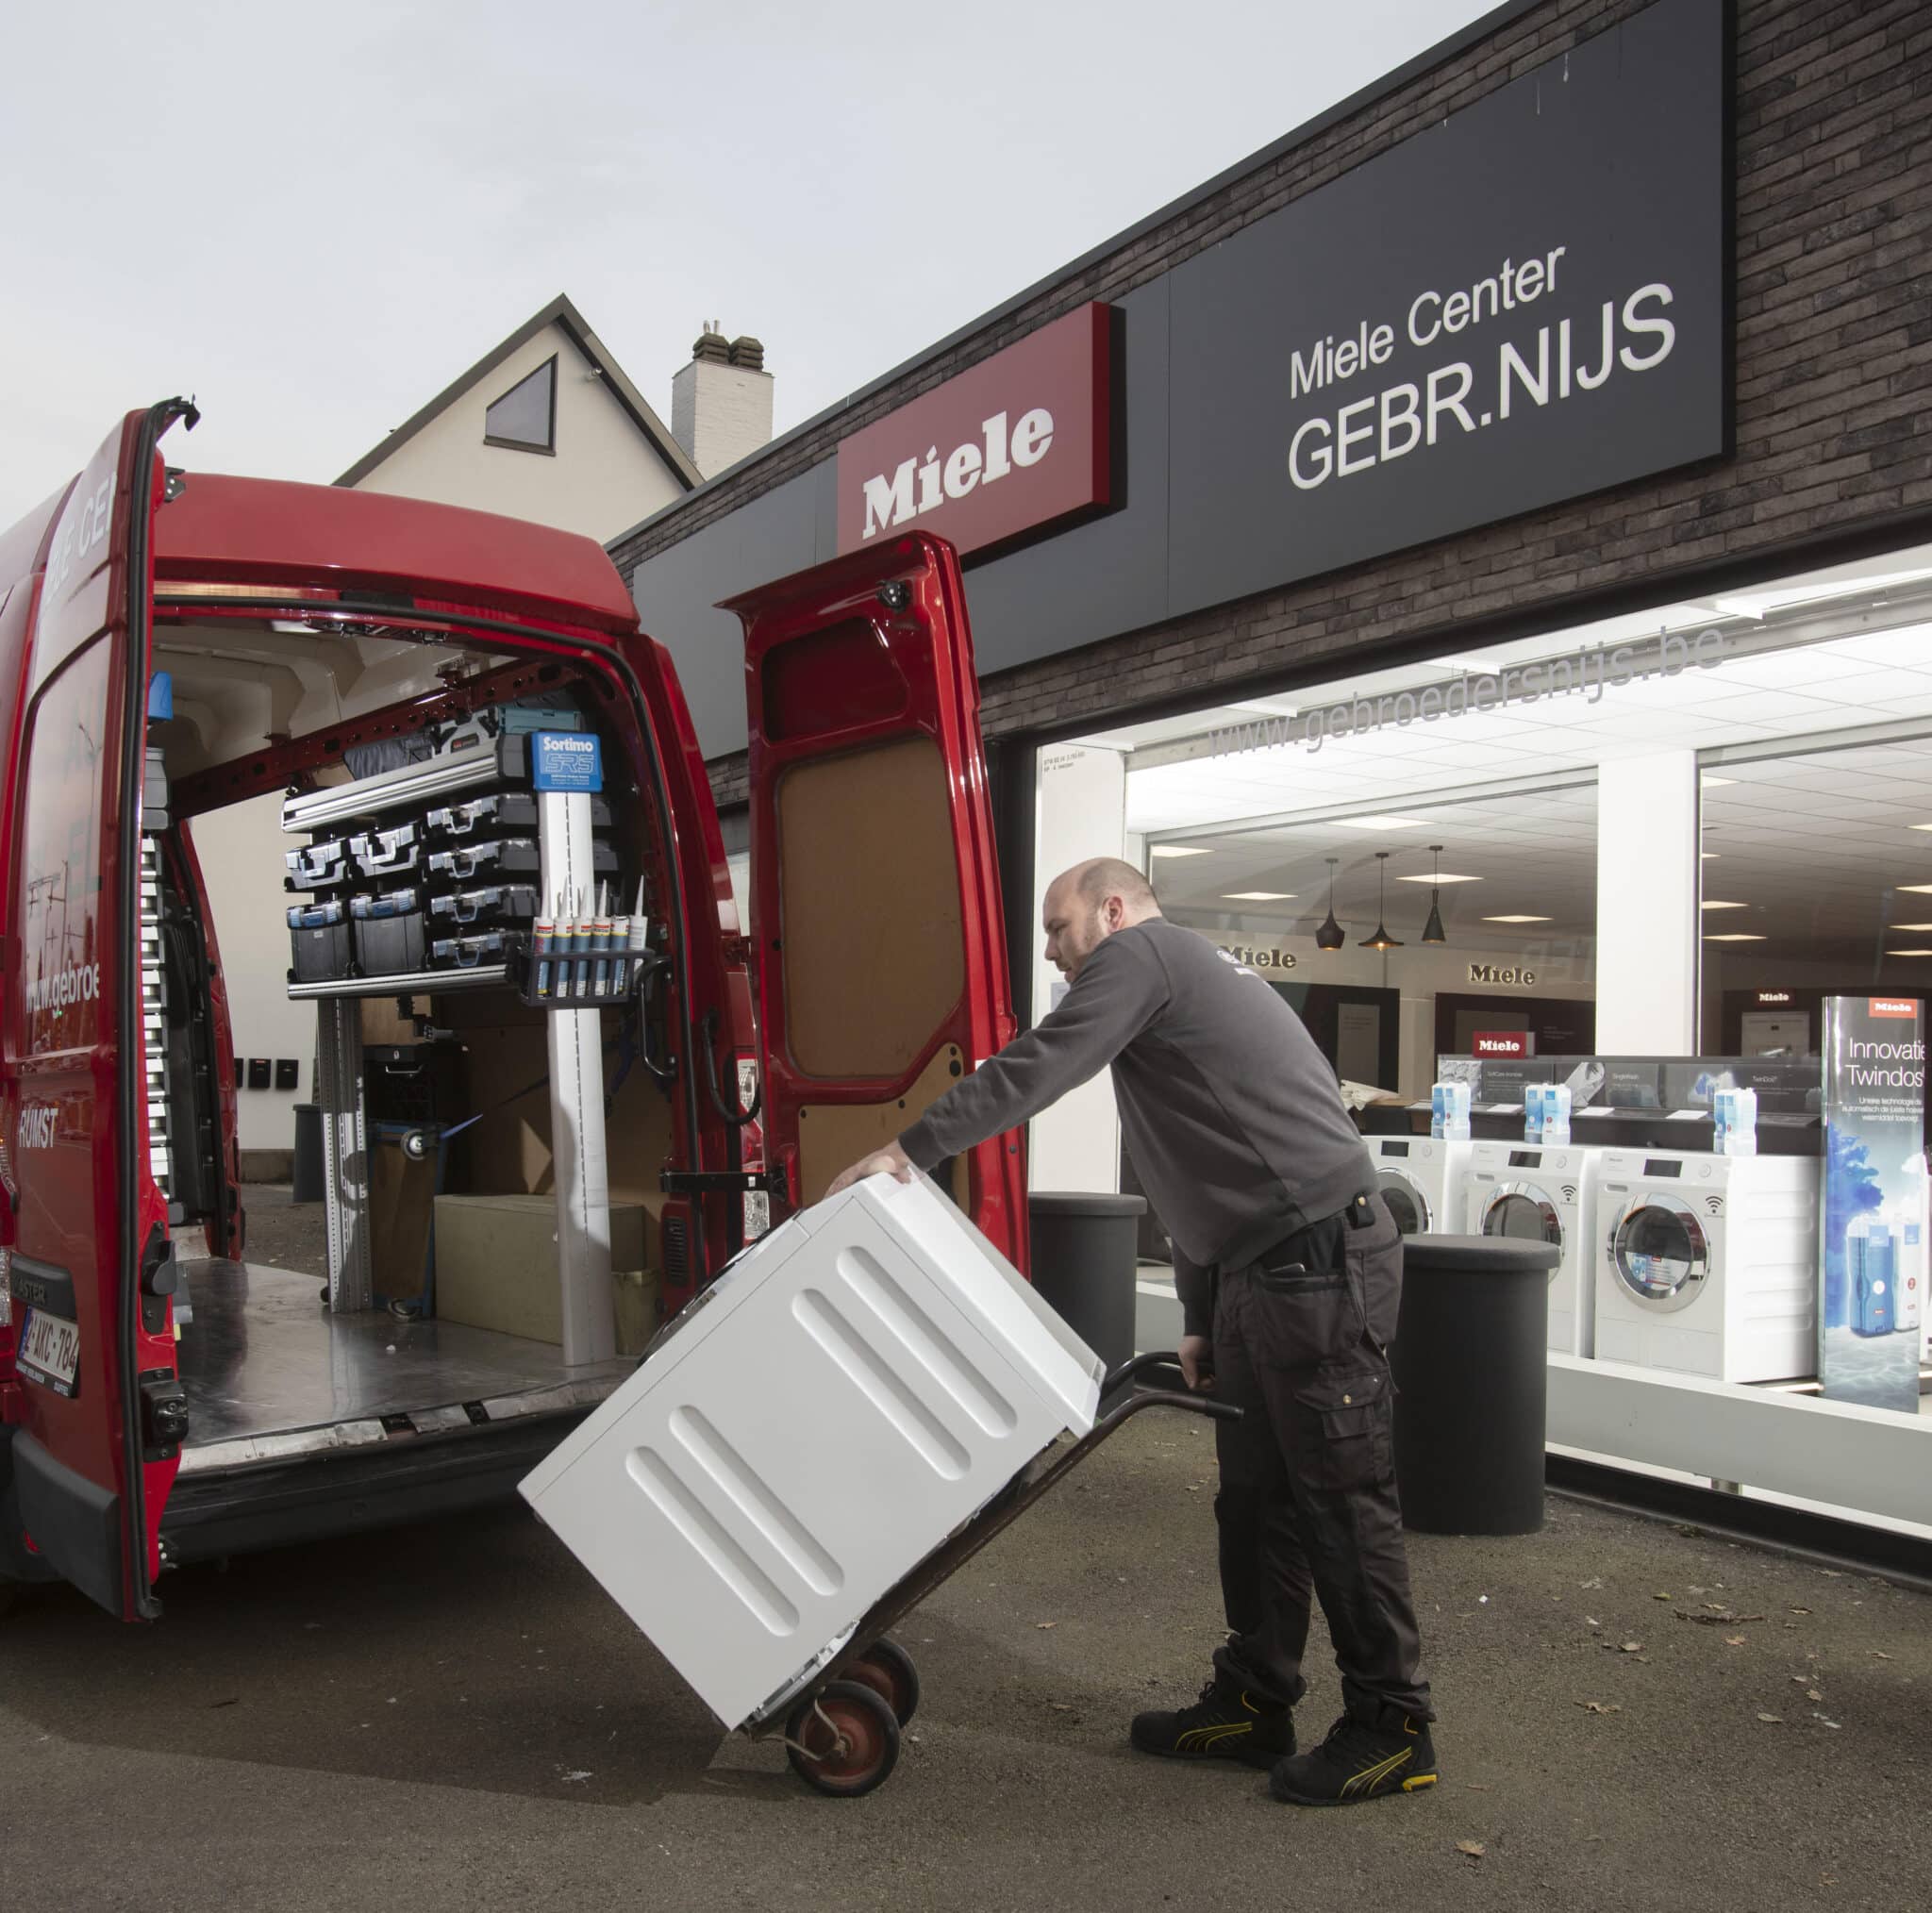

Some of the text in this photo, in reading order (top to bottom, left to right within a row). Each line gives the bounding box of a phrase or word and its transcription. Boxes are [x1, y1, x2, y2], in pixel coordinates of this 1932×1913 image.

[1291, 246, 1567, 400] Miele Center
[1289, 283, 1676, 491] GEBR.NIJS
[862, 408, 1055, 541] Miele
[1208, 625, 1724, 759] www.gebroedersnijs.be
[542, 736, 593, 753] Sortimo
[1470, 963, 1536, 986] Miele
[1478, 1040, 1521, 1052] Miele
[19, 1107, 58, 1148] RUMST
